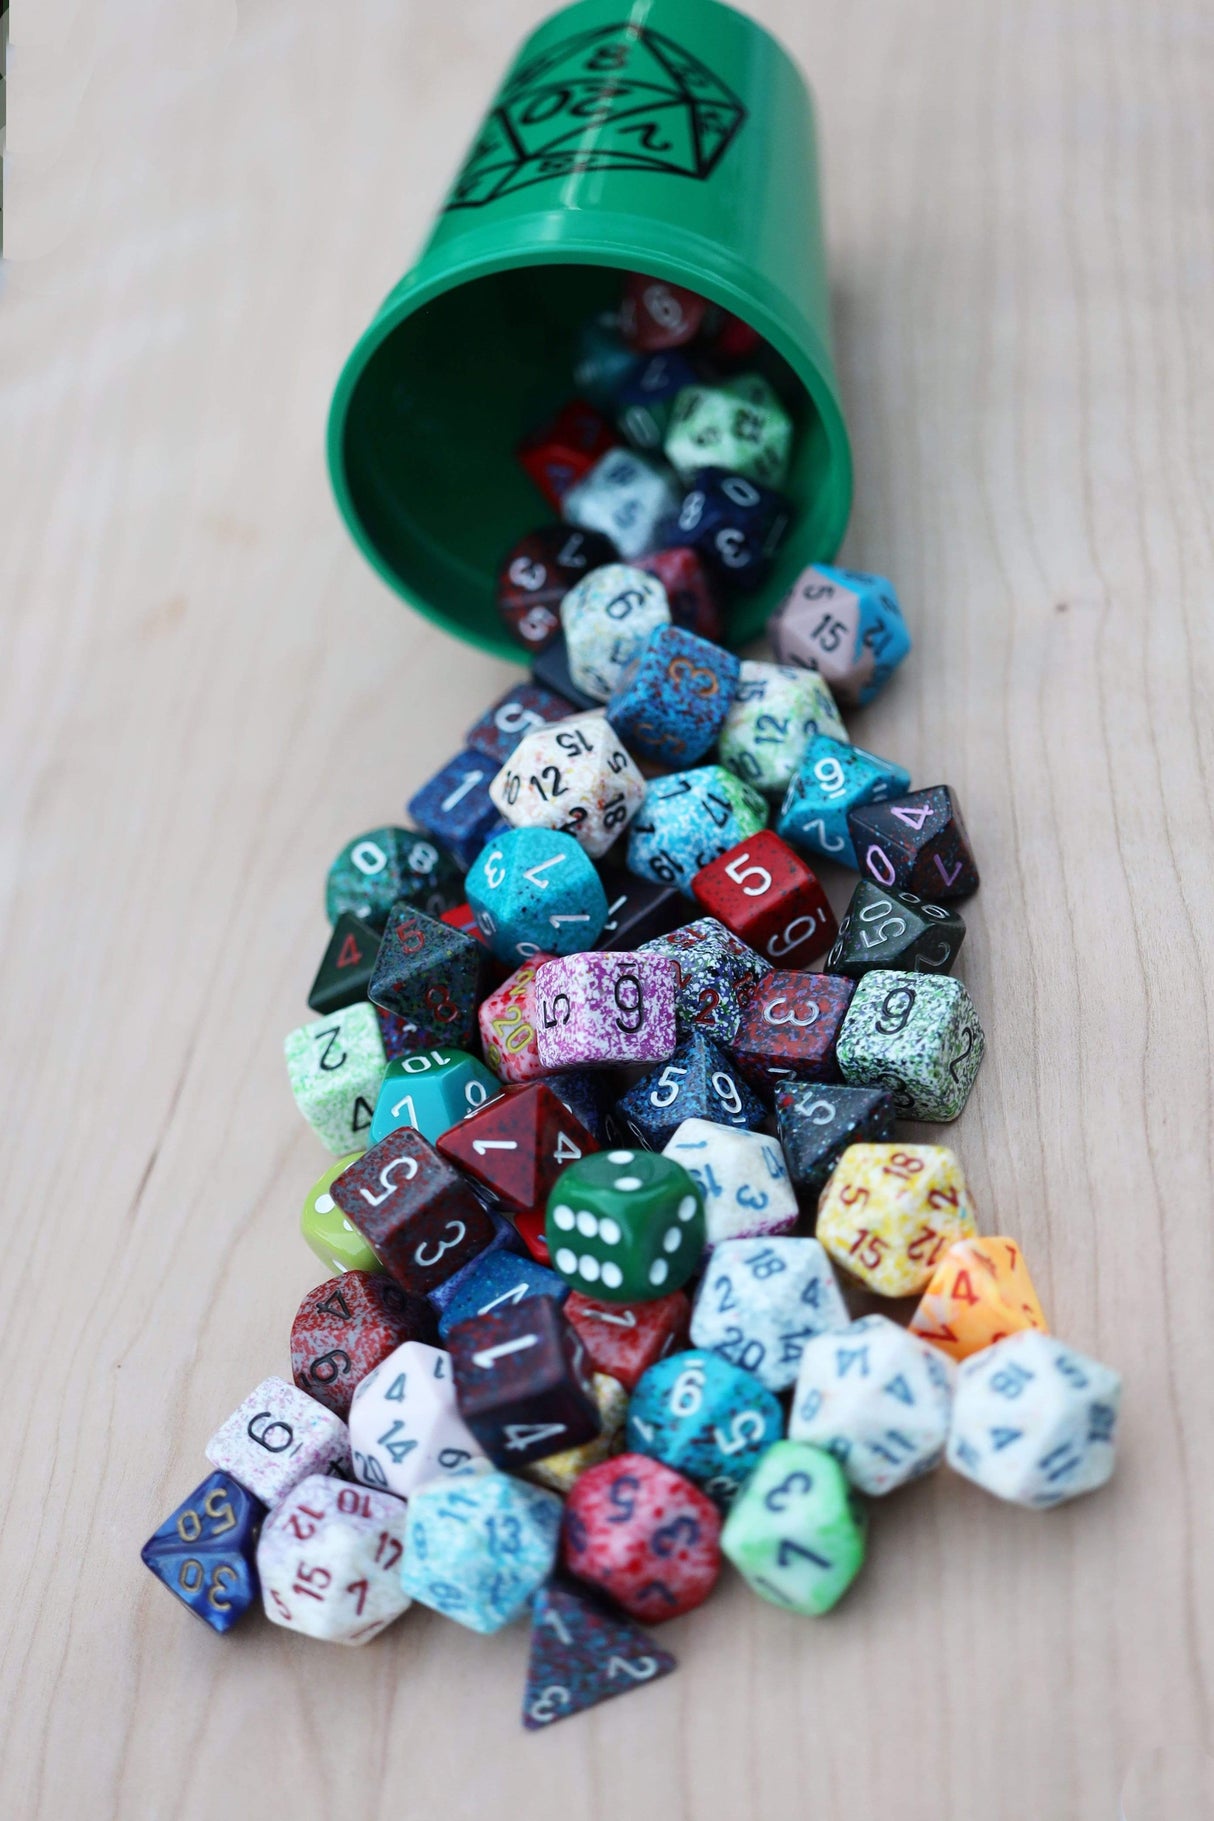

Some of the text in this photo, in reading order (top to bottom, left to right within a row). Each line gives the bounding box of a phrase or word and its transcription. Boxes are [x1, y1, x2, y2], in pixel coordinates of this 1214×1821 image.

[811, 614, 848, 653] 15
[669, 657, 719, 697] 3
[556, 730, 594, 758] 15
[755, 714, 790, 744] 12
[606, 751, 627, 774] 5
[440, 769, 485, 813] 1
[530, 765, 569, 801] 12
[601, 792, 628, 829] 18
[890, 804, 934, 830] 4
[803, 818, 845, 852] 2
[351, 841, 387, 875] 0
[408, 843, 439, 874] 8
[483, 851, 506, 889] 3
[724, 852, 773, 897] 5
[866, 844, 896, 887] 0
[395, 918, 426, 955] 5
[858, 900, 907, 949] 50
[336, 933, 363, 969] 4
[509, 970, 533, 997] 2
[425, 985, 458, 1024] 8
[542, 993, 571, 1030] 5
[695, 988, 720, 1025] 2
[763, 997, 820, 1027] 3
[314, 1025, 348, 1071] 2
[492, 1006, 535, 1054] 20
[401, 1050, 451, 1074] 10
[950, 1026, 973, 1084] 2
[650, 1066, 688, 1108] 5
[794, 1091, 837, 1126] 5
[552, 1131, 582, 1164] 4
[359, 1156, 418, 1207] 5
[883, 1152, 925, 1181] 18
[735, 1184, 769, 1211] 3
[839, 1183, 870, 1208] 5
[414, 1219, 466, 1267] 3
[848, 1227, 890, 1270] 15
[744, 1248, 788, 1281] 18
[316, 1289, 351, 1320] 4
[478, 1282, 530, 1316] 1
[715, 1275, 737, 1314] 2
[801, 1277, 820, 1310] 4
[951, 1269, 980, 1307] 4
[472, 1334, 541, 1370] 1
[716, 1326, 766, 1371] 20
[384, 1372, 407, 1403] 4
[377, 1420, 418, 1463] 14
[502, 1423, 567, 1451] 4
[714, 1410, 767, 1454] 5
[354, 1451, 389, 1488] 20
[336, 1487, 372, 1518] 10
[606, 1475, 641, 1524] 5
[765, 1471, 813, 1512] 3
[175, 1488, 236, 1542] 50
[284, 1505, 325, 1540] 12
[373, 1531, 404, 1571] 17
[180, 1557, 238, 1611] 30
[293, 1561, 332, 1602] 15
[545, 1608, 574, 1644] 1
[608, 1655, 658, 1680] 2
[531, 1685, 570, 1722] 3
